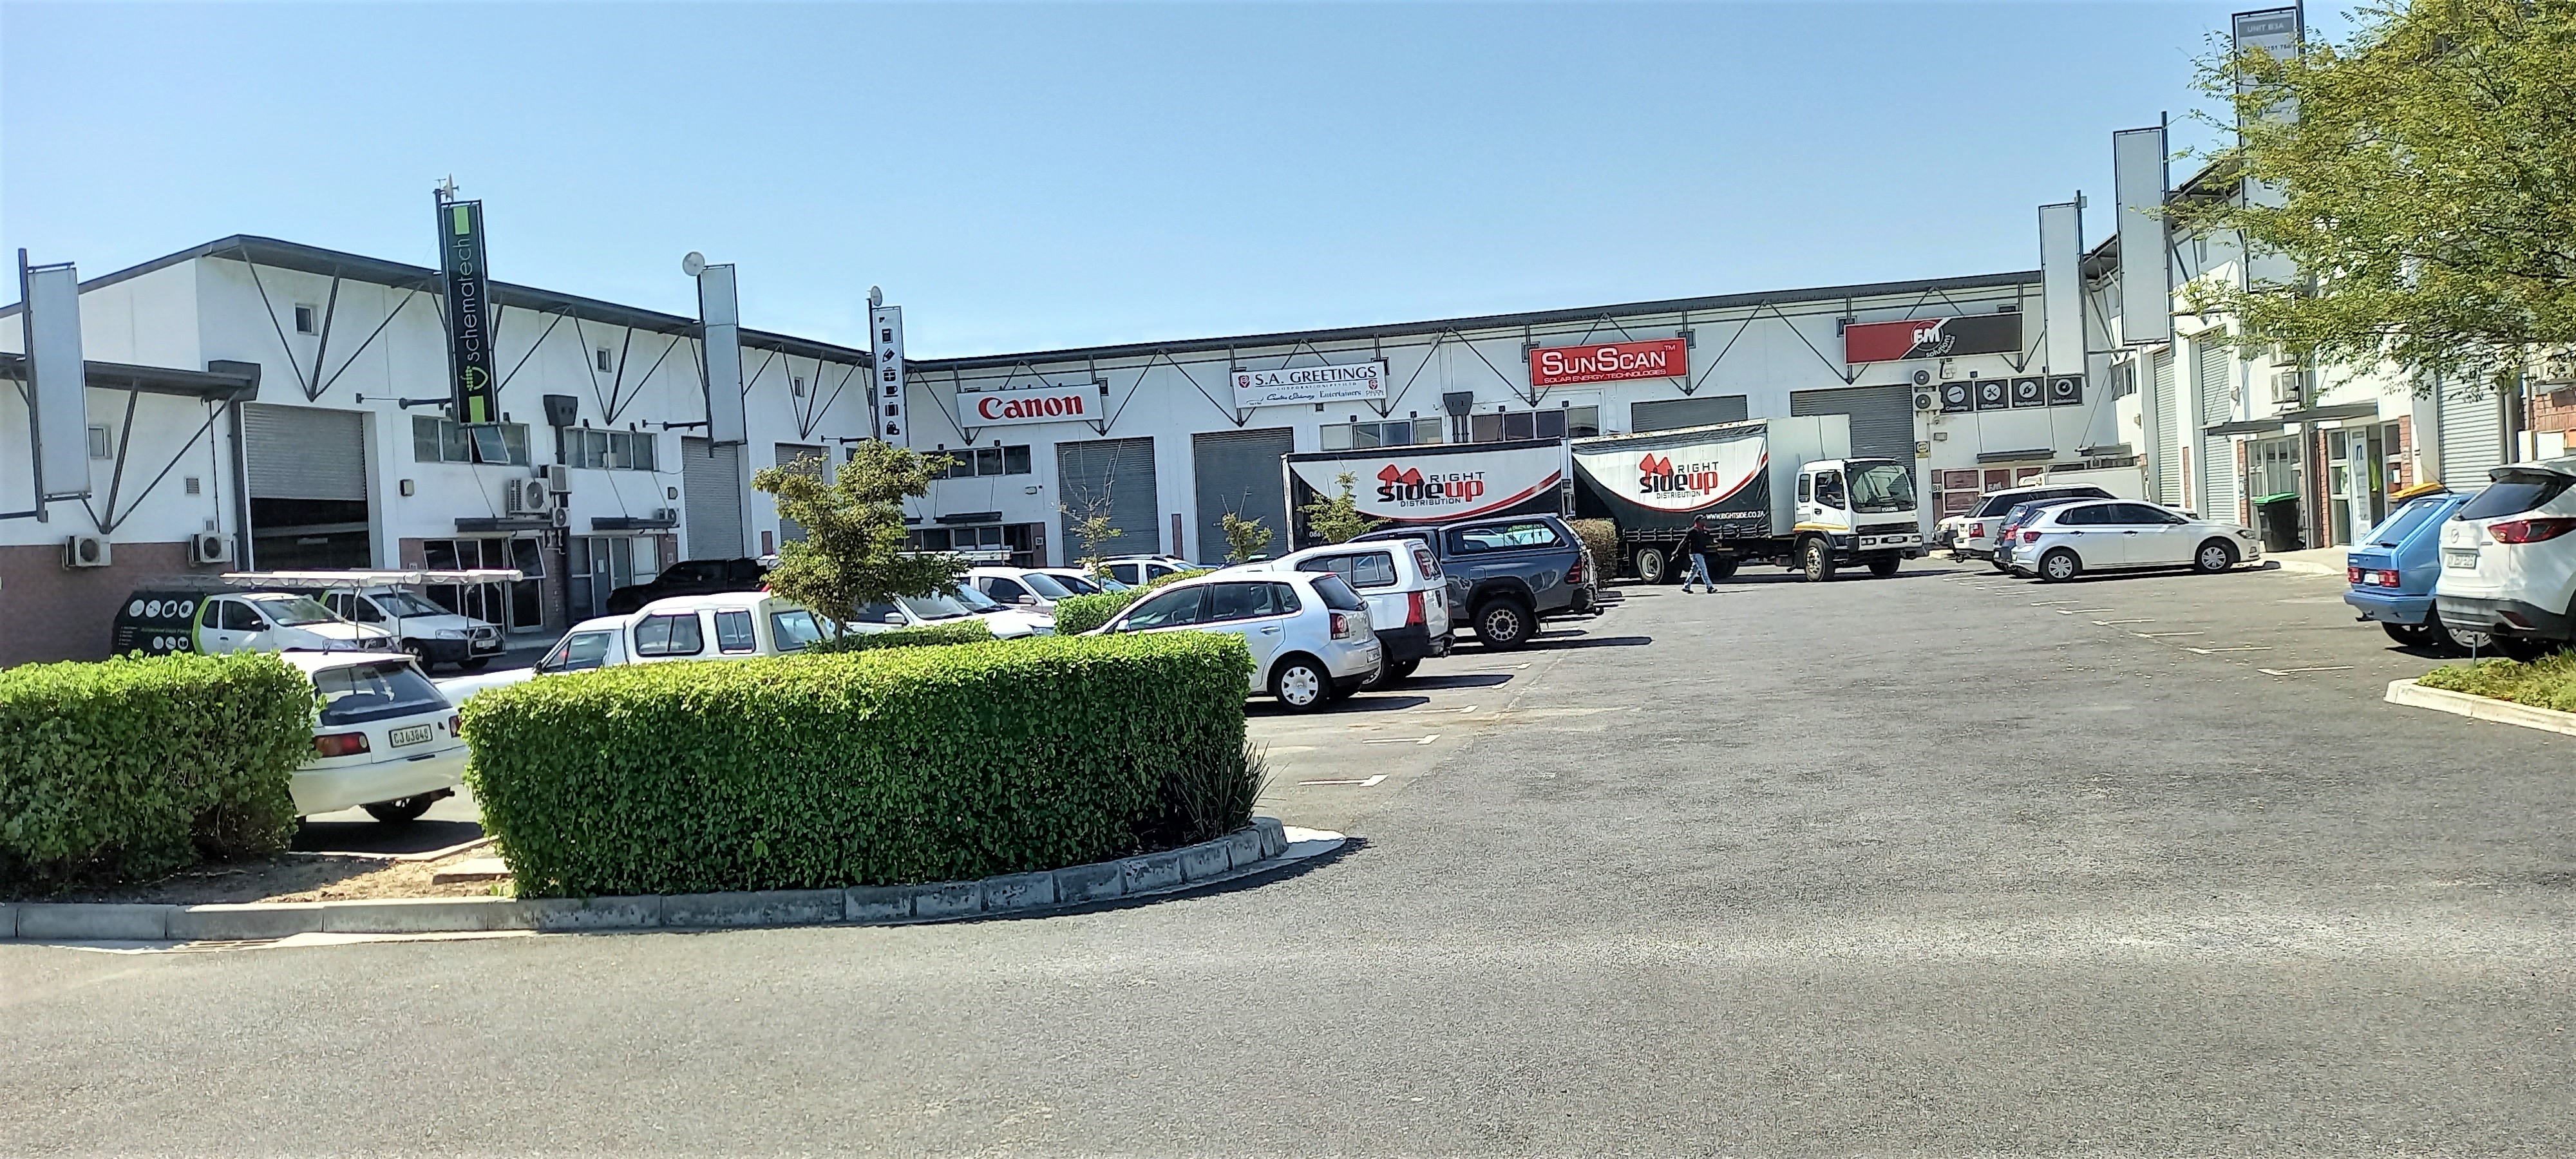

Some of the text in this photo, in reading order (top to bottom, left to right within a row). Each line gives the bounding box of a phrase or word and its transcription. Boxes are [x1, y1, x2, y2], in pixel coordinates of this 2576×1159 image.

[2248, 24, 2267, 32] UNIT
[453, 238, 480, 362] schematech
[1926, 334, 1951, 357] solutions
[1255, 366, 1377, 386] S.A. GREETINGS
[1606, 369, 1667, 379] TECHNOLOGIES
[1320, 390, 1361, 398] Entertainers
[978, 395, 1083, 420] Canon
[1678, 461, 1719, 473] RIGHT
[1430, 471, 1485, 483] RIGHT
[1656, 491, 1701, 499] DISTRIBUTION
[1400, 498, 1461, 507] DISTRIBUTION
